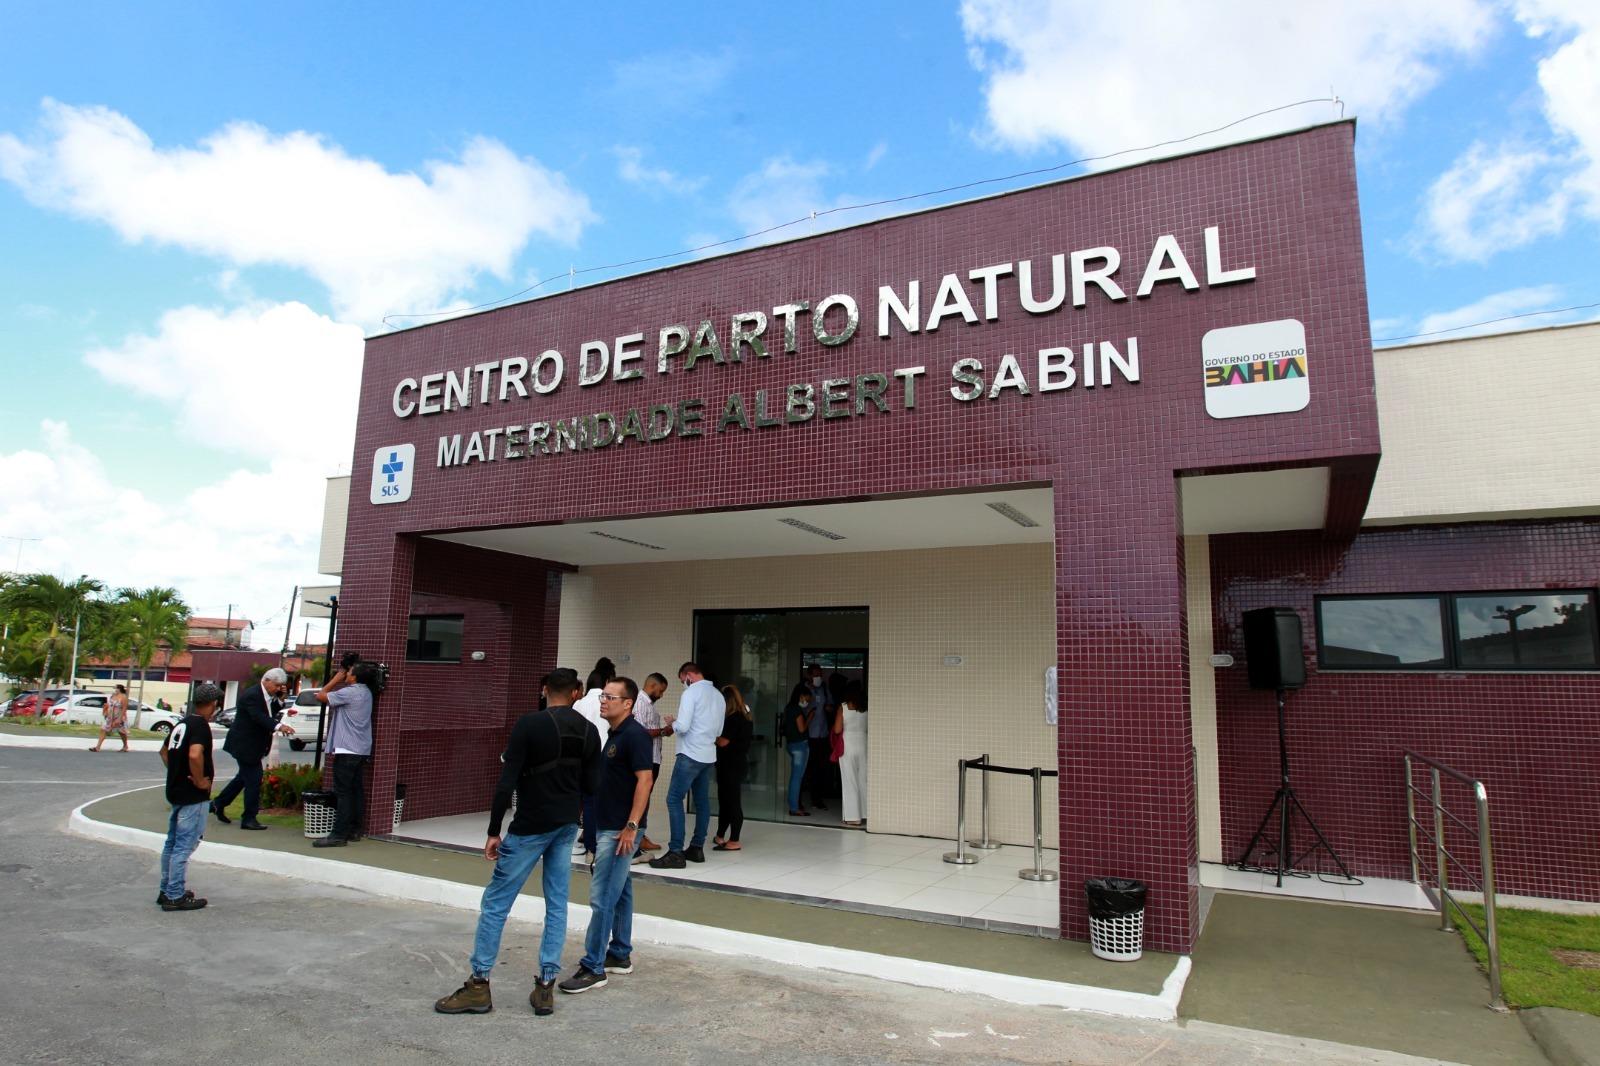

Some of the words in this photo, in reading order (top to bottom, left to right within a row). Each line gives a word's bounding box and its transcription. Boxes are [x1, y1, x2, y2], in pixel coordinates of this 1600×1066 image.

[392, 349, 565, 418] CENTRO
[578, 332, 644, 387] DE
[657, 293, 860, 373] PARTO
[878, 226, 1256, 338] NATURAL
[1204, 355, 1250, 367] GOVERNO
[1252, 353, 1266, 361] DO
[1268, 347, 1305, 359] ESTADO
[1205, 356, 1307, 388] BAHIA
[436, 398, 704, 468] MATERNIDADE
[717, 366, 926, 432] ALBERT
[949, 337, 1141, 402] SABIN
[381, 484, 400, 497] SUS
